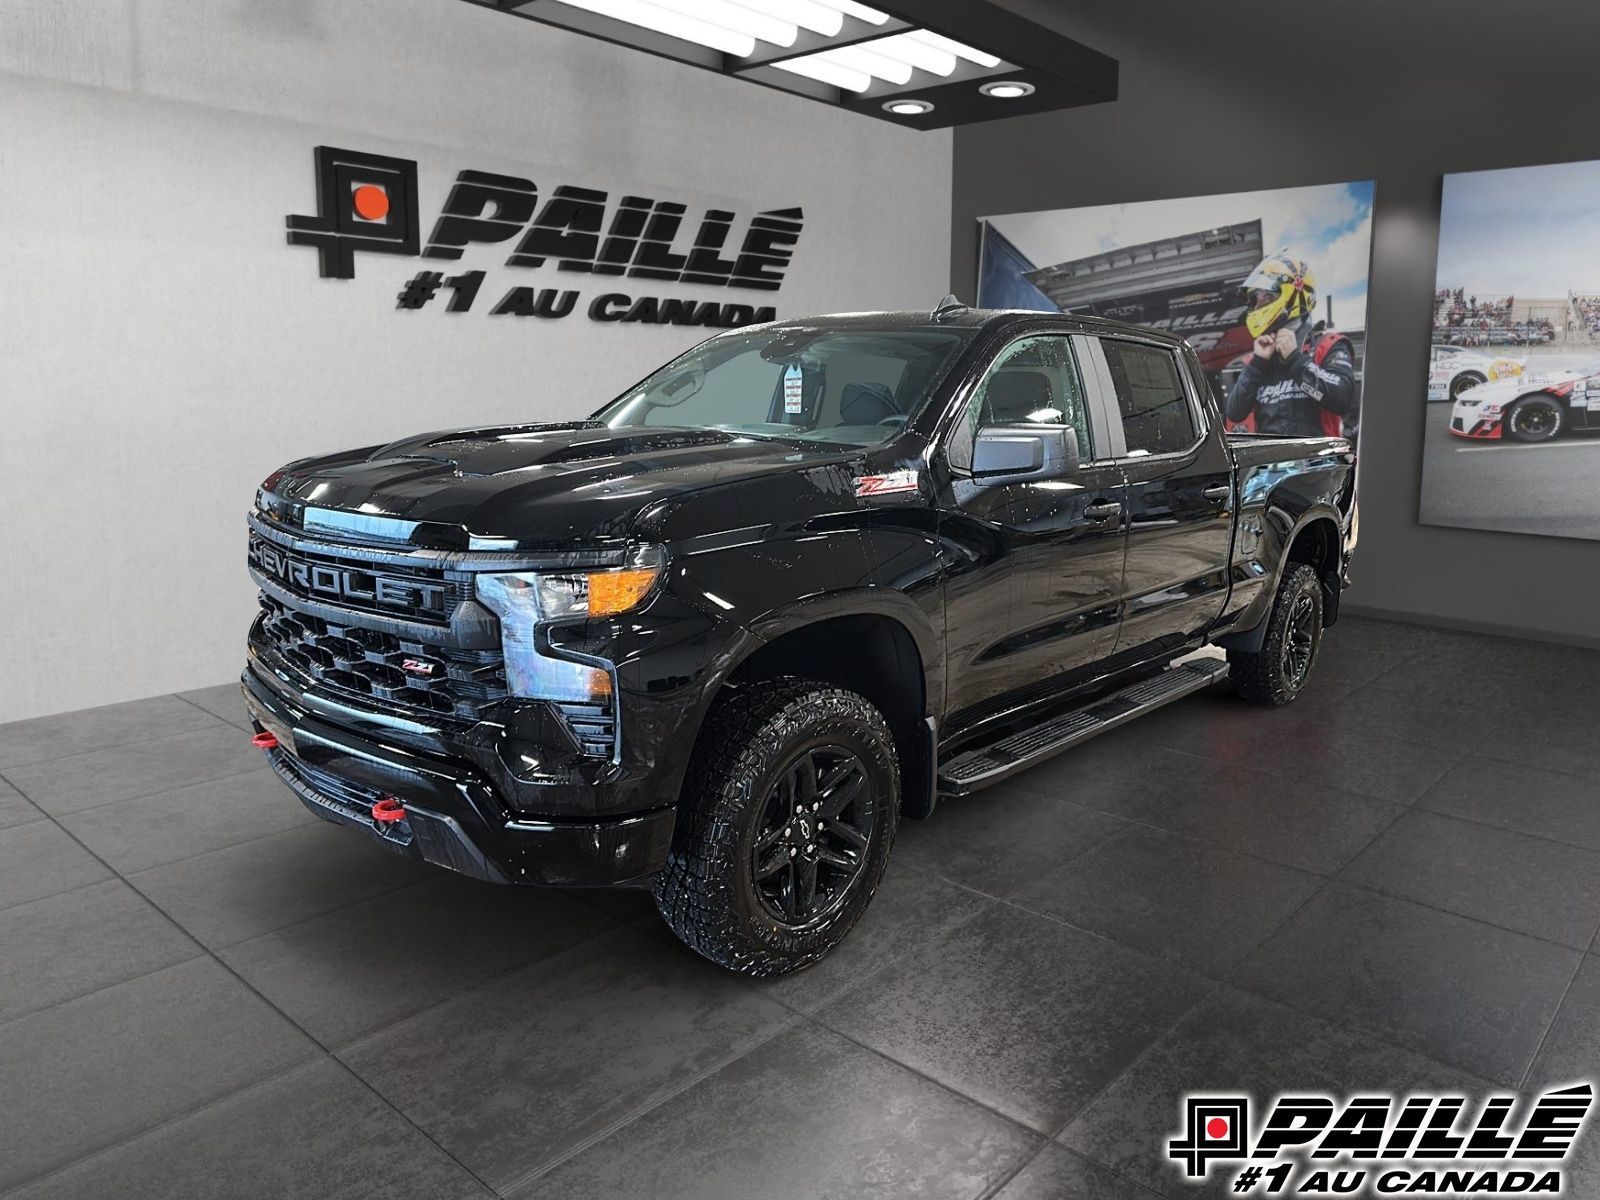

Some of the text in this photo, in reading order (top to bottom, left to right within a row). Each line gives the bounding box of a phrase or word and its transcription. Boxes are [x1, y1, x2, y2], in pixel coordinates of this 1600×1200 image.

[421, 169, 804, 291] PAILLÉ
[395, 270, 777, 328] #1 AU CANADA
